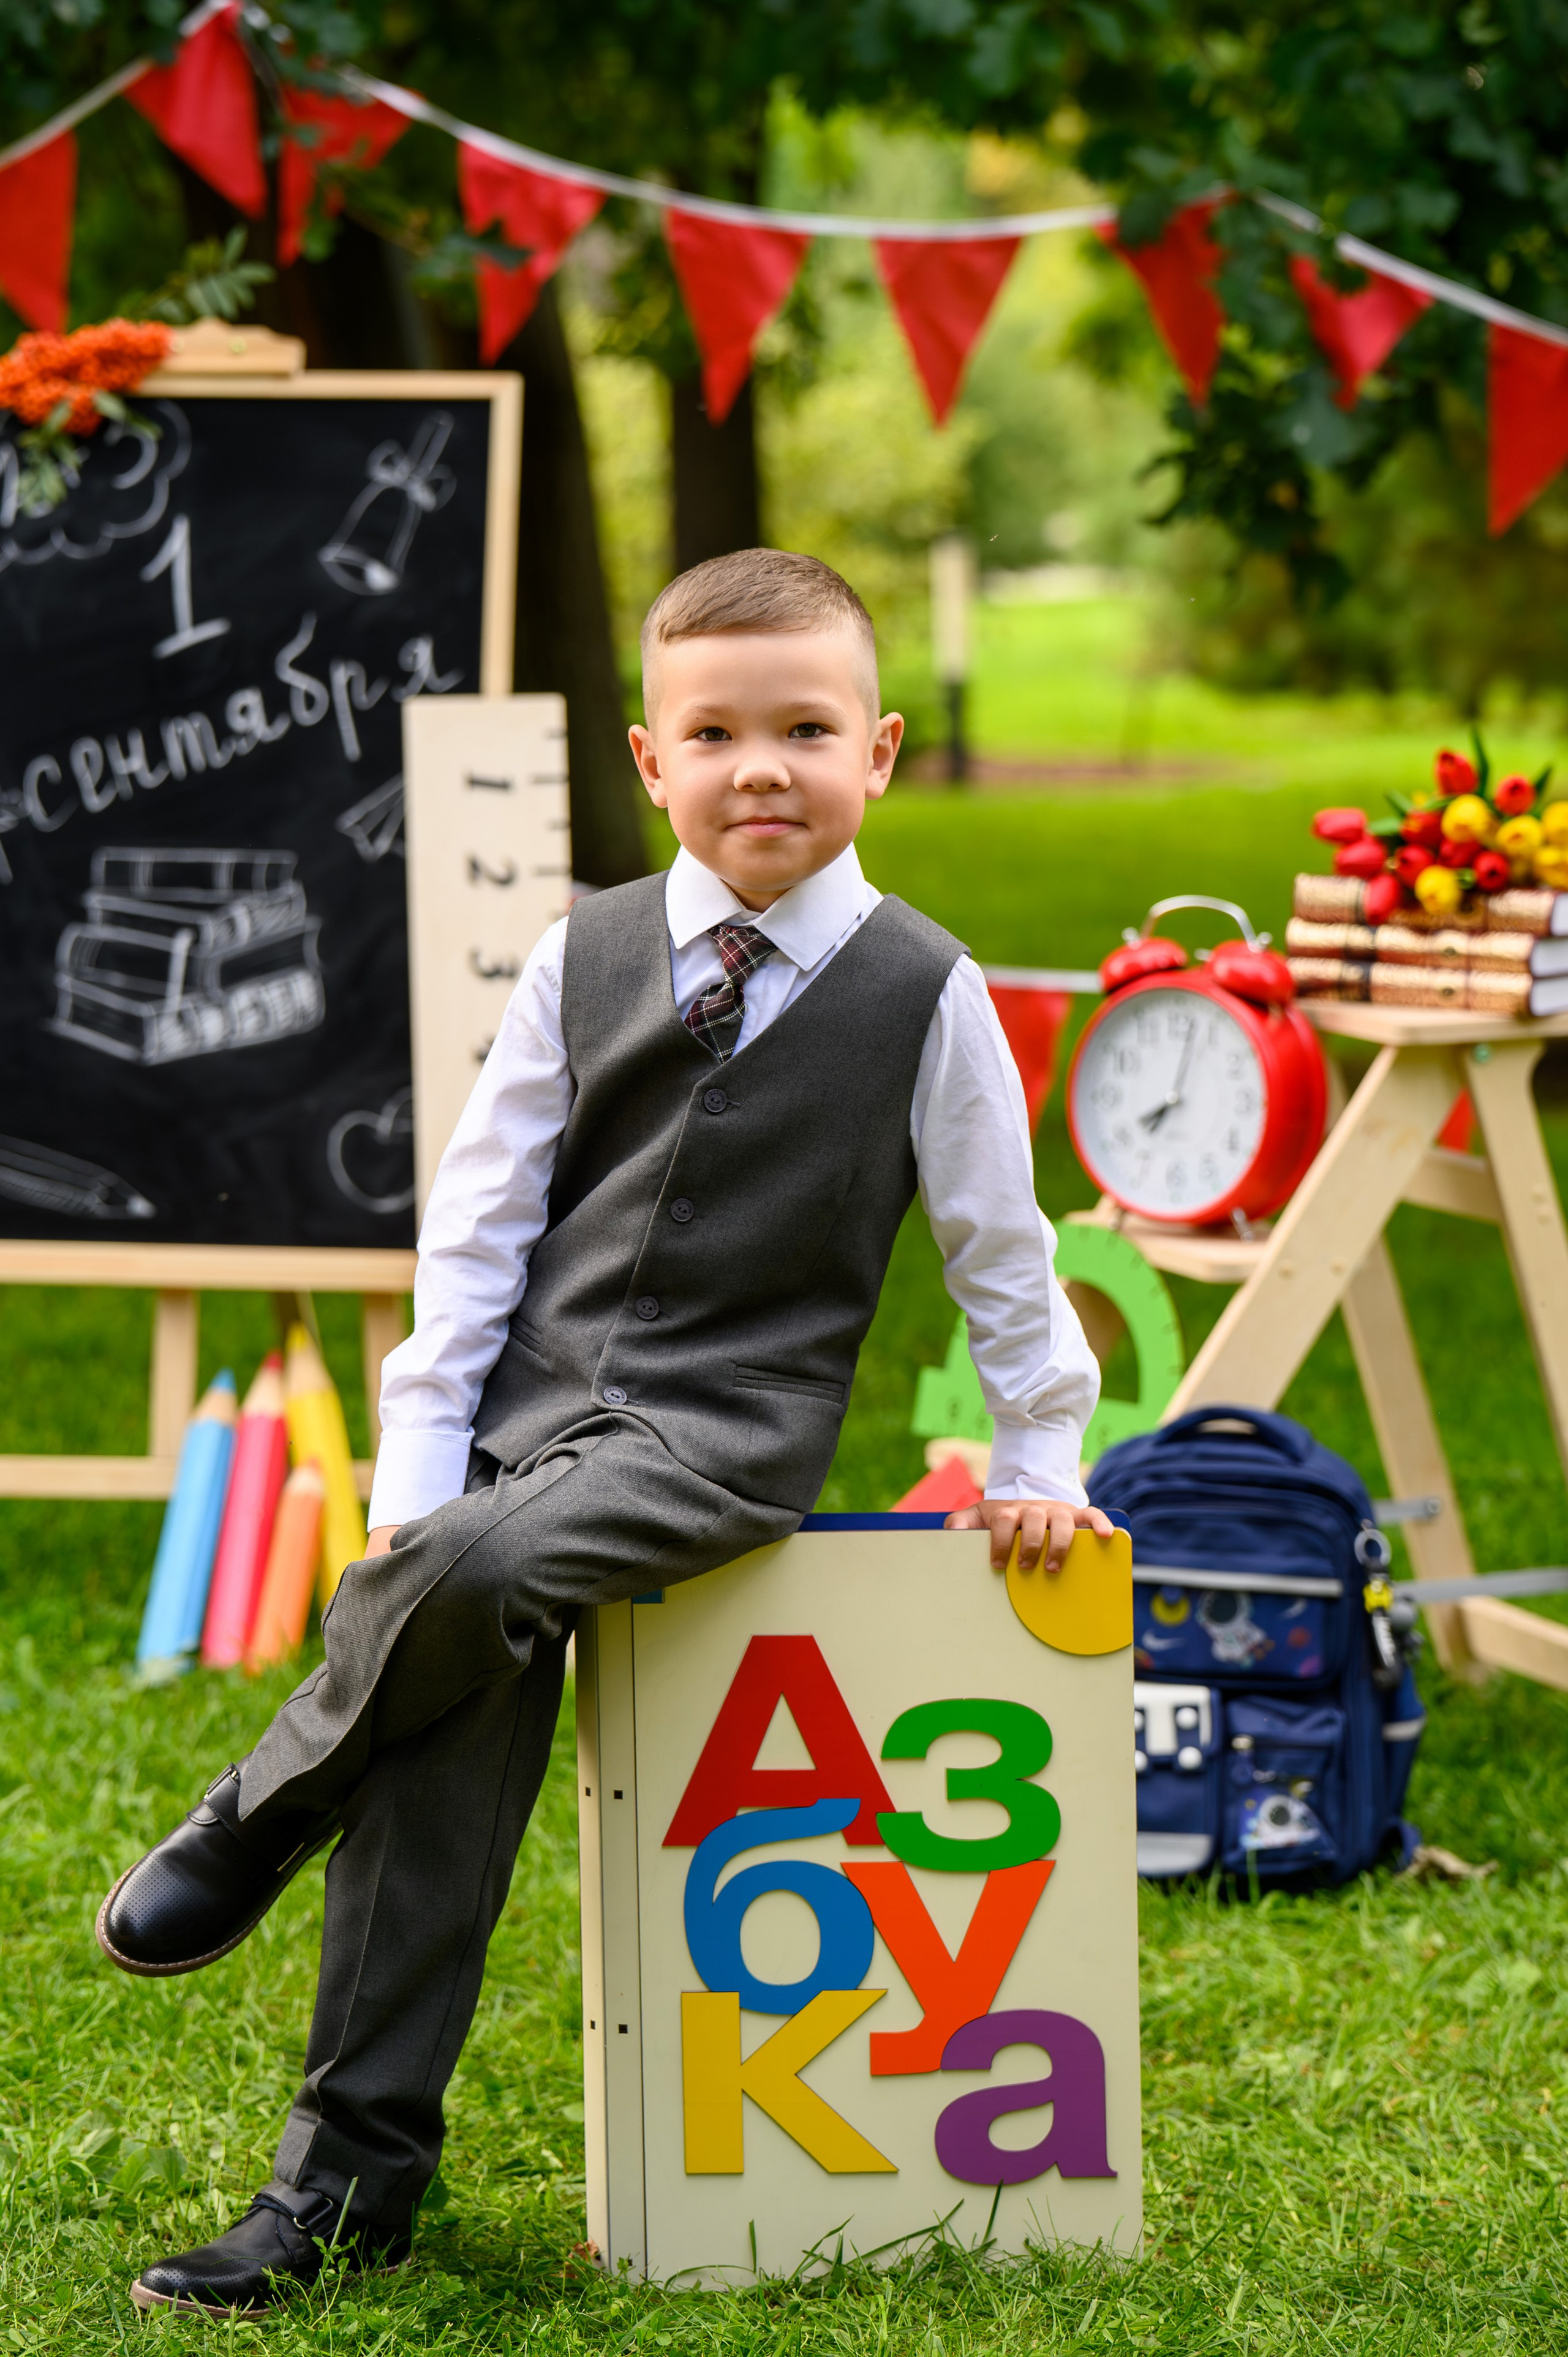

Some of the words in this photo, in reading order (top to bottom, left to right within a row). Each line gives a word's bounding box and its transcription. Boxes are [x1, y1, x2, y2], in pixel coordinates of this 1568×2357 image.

[141, 513, 232, 659] 1
[22, 611, 464, 832] сентября
[464, 771, 514, 794] 1
[466, 854, 517, 888] 2
[469, 948, 518, 982] 3
